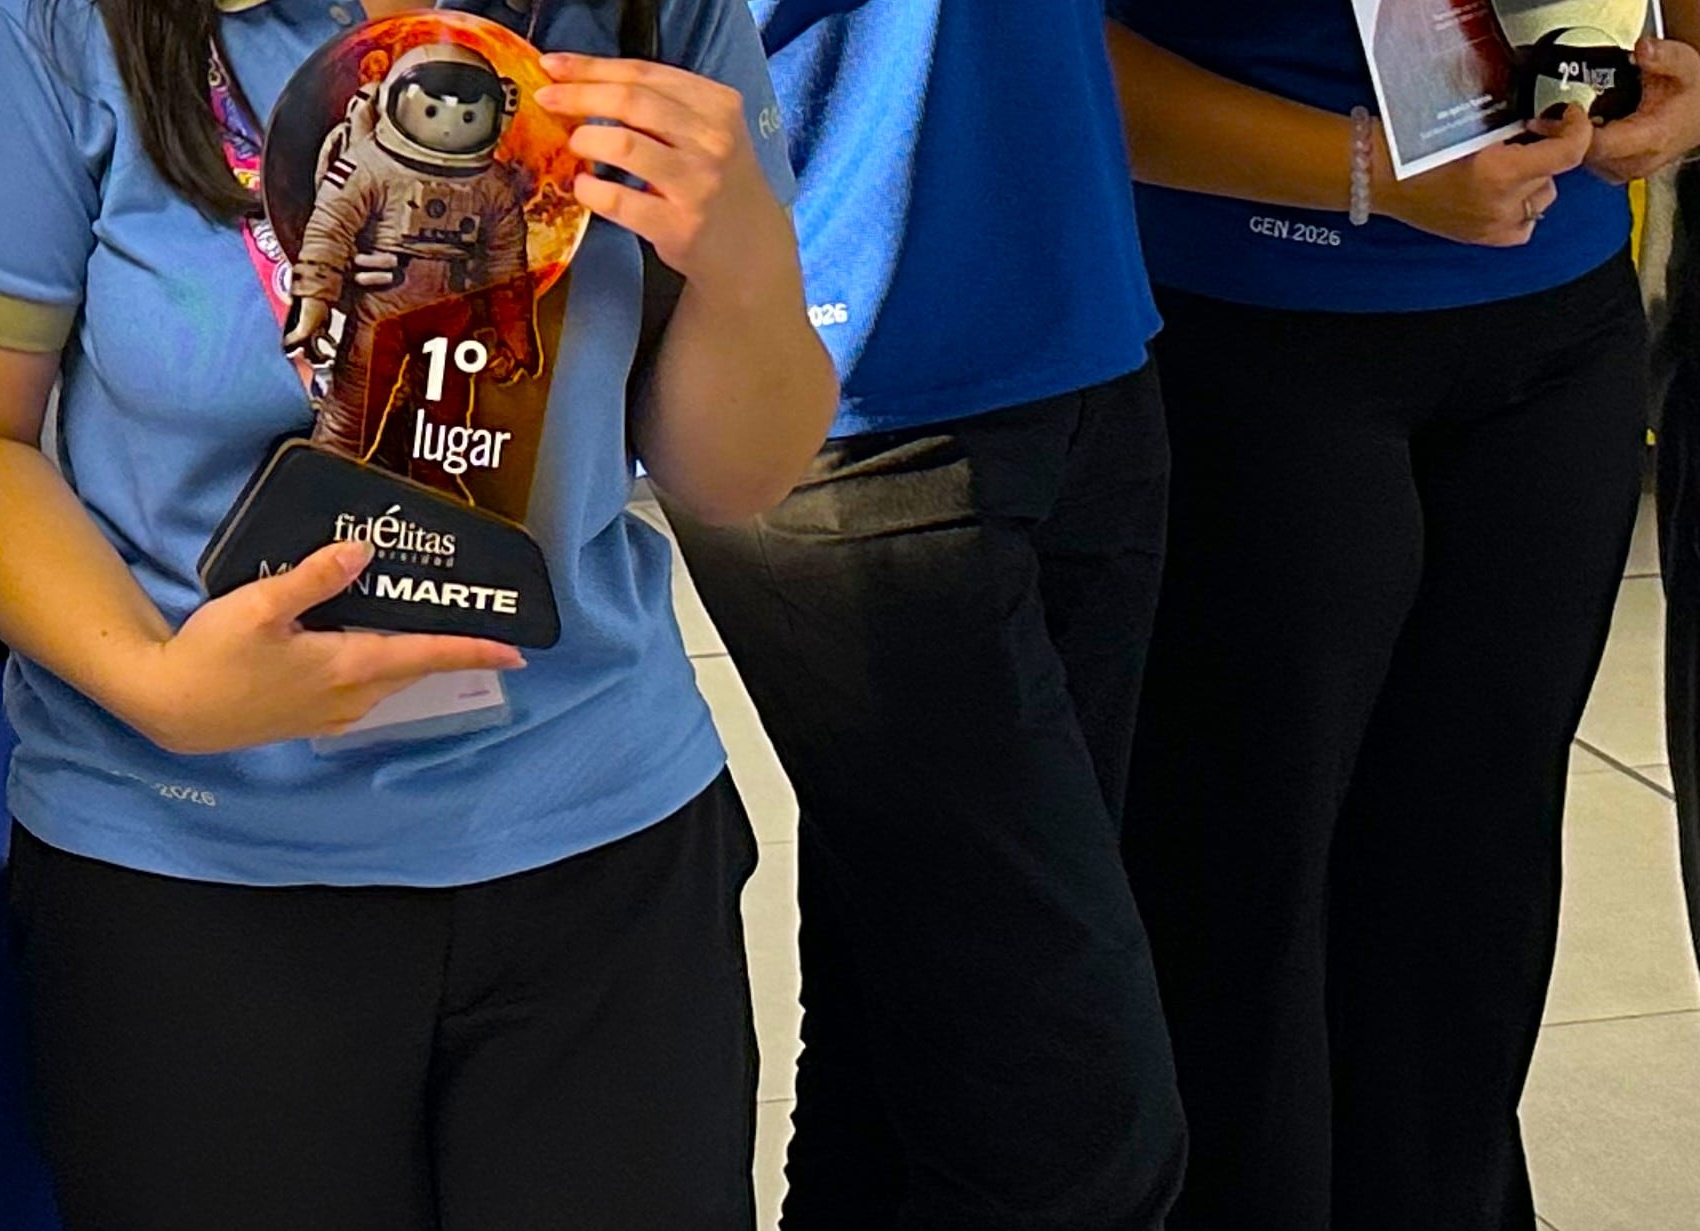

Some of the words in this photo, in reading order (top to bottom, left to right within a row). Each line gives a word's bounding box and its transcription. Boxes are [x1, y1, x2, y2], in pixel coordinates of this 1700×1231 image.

[1292, 223, 1341, 246] 2026
[807, 302, 848, 327] 026
[412, 408, 512, 475] lugar
[333, 504, 456, 555] fidélitas
[375, 574, 519, 615] MARTE
